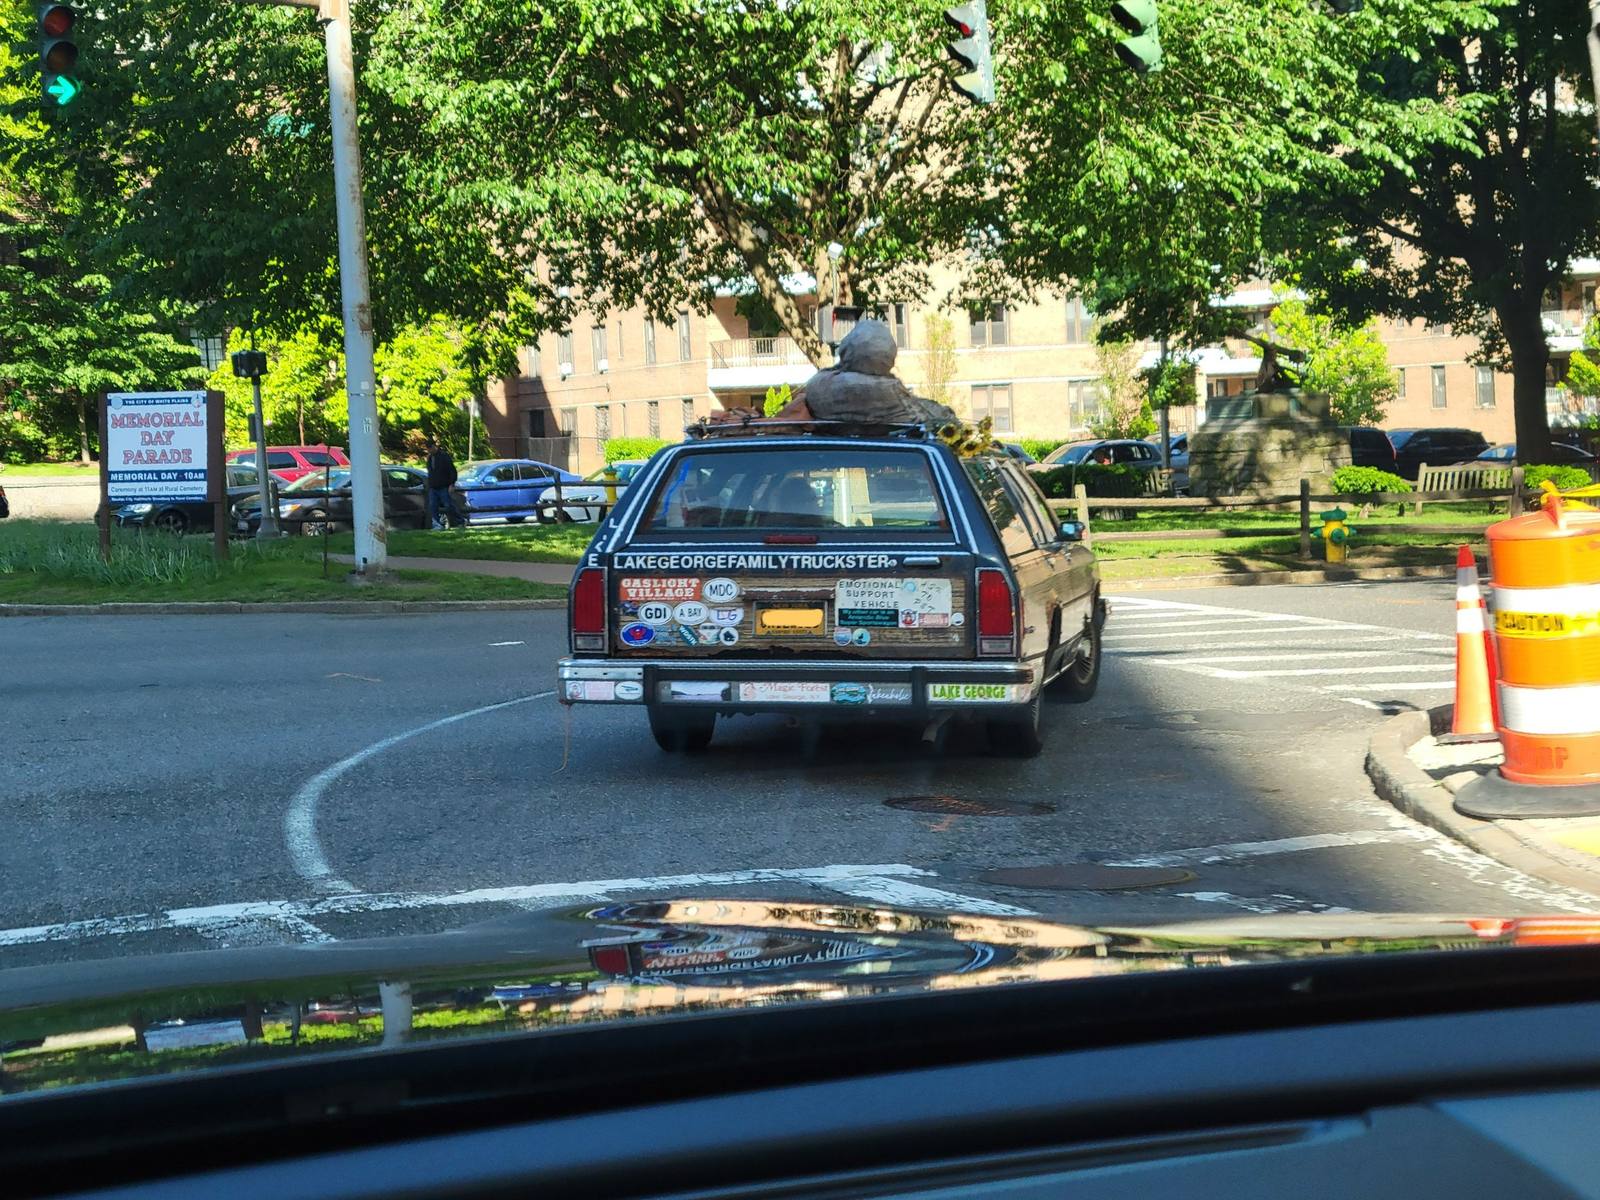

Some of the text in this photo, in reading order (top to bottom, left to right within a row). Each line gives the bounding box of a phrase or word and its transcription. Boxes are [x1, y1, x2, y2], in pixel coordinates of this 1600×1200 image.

[111, 411, 204, 429] MEMORIAL
[141, 430, 175, 446] DAY
[123, 448, 193, 465] PARADE
[110, 472, 158, 481] MEMORIAL
[160, 471, 178, 480] DAY
[184, 471, 205, 480] 10AM
[179, 484, 203, 492] Cemetery
[621, 578, 700, 588] GASLIGHT
[839, 580, 901, 589] EMOTIONAL
[627, 588, 695, 597] VILLAGE
[709, 584, 734, 597] MDC
[846, 590, 894, 599] SUPPORT
[854, 600, 899, 608] VEHICLE
[644, 607, 668, 619] GDI
[932, 685, 1006, 699] LAKE GEORGE
